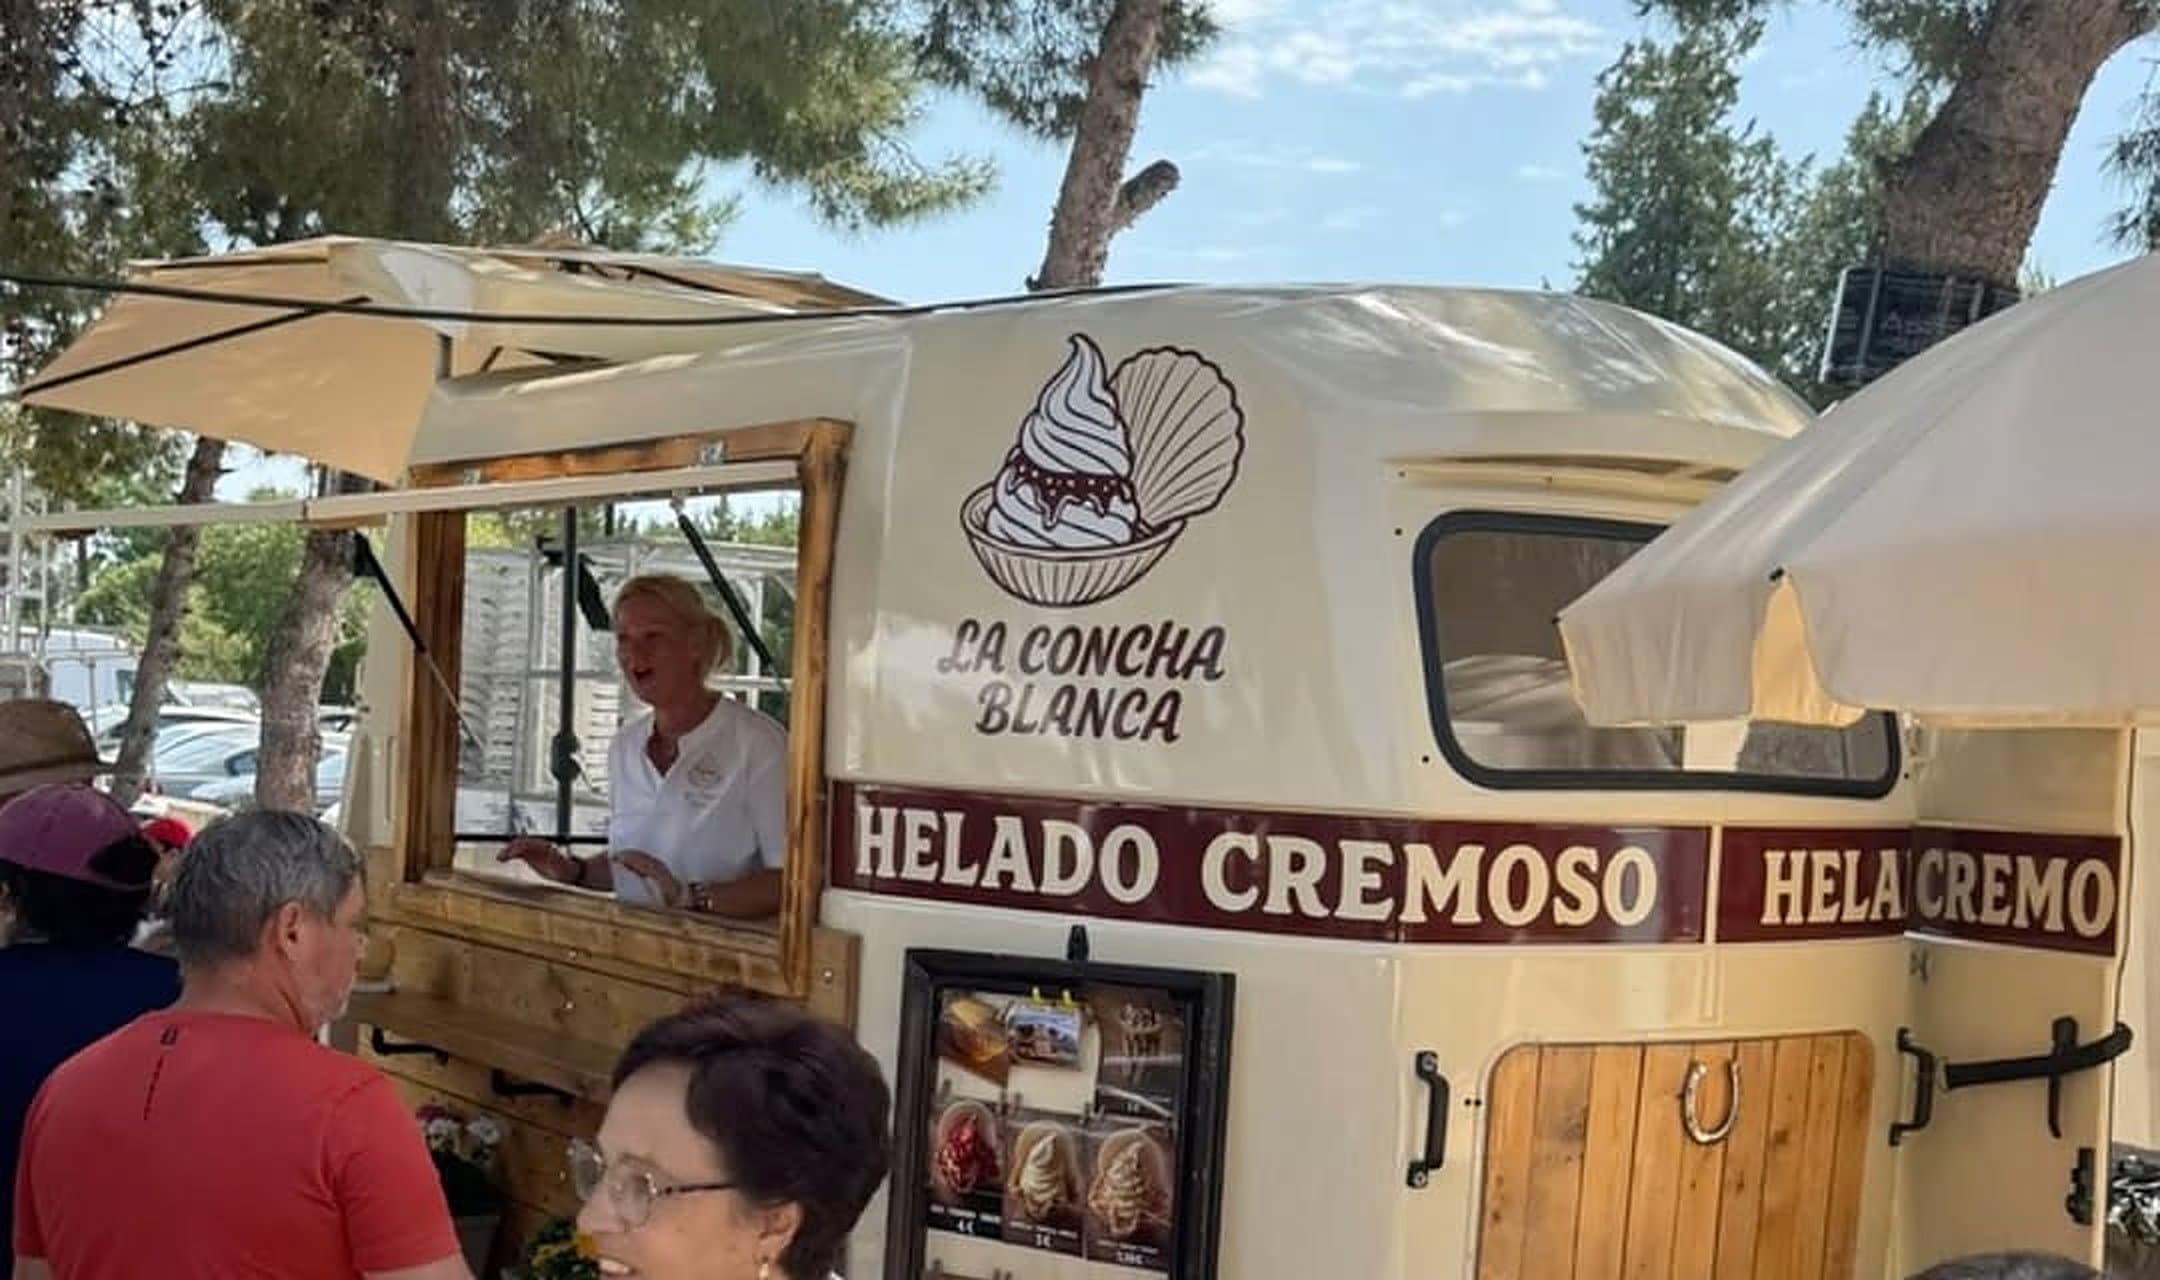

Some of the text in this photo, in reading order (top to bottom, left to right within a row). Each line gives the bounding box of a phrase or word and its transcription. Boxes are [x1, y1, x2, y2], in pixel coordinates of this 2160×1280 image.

[936, 618, 1226, 682] LA CONCHA
[974, 680, 1183, 744] BLANCA
[854, 805, 1659, 928] HELADO CREMOSO
[1759, 848, 1912, 926] HELA
[1915, 848, 2117, 938] CREMO
